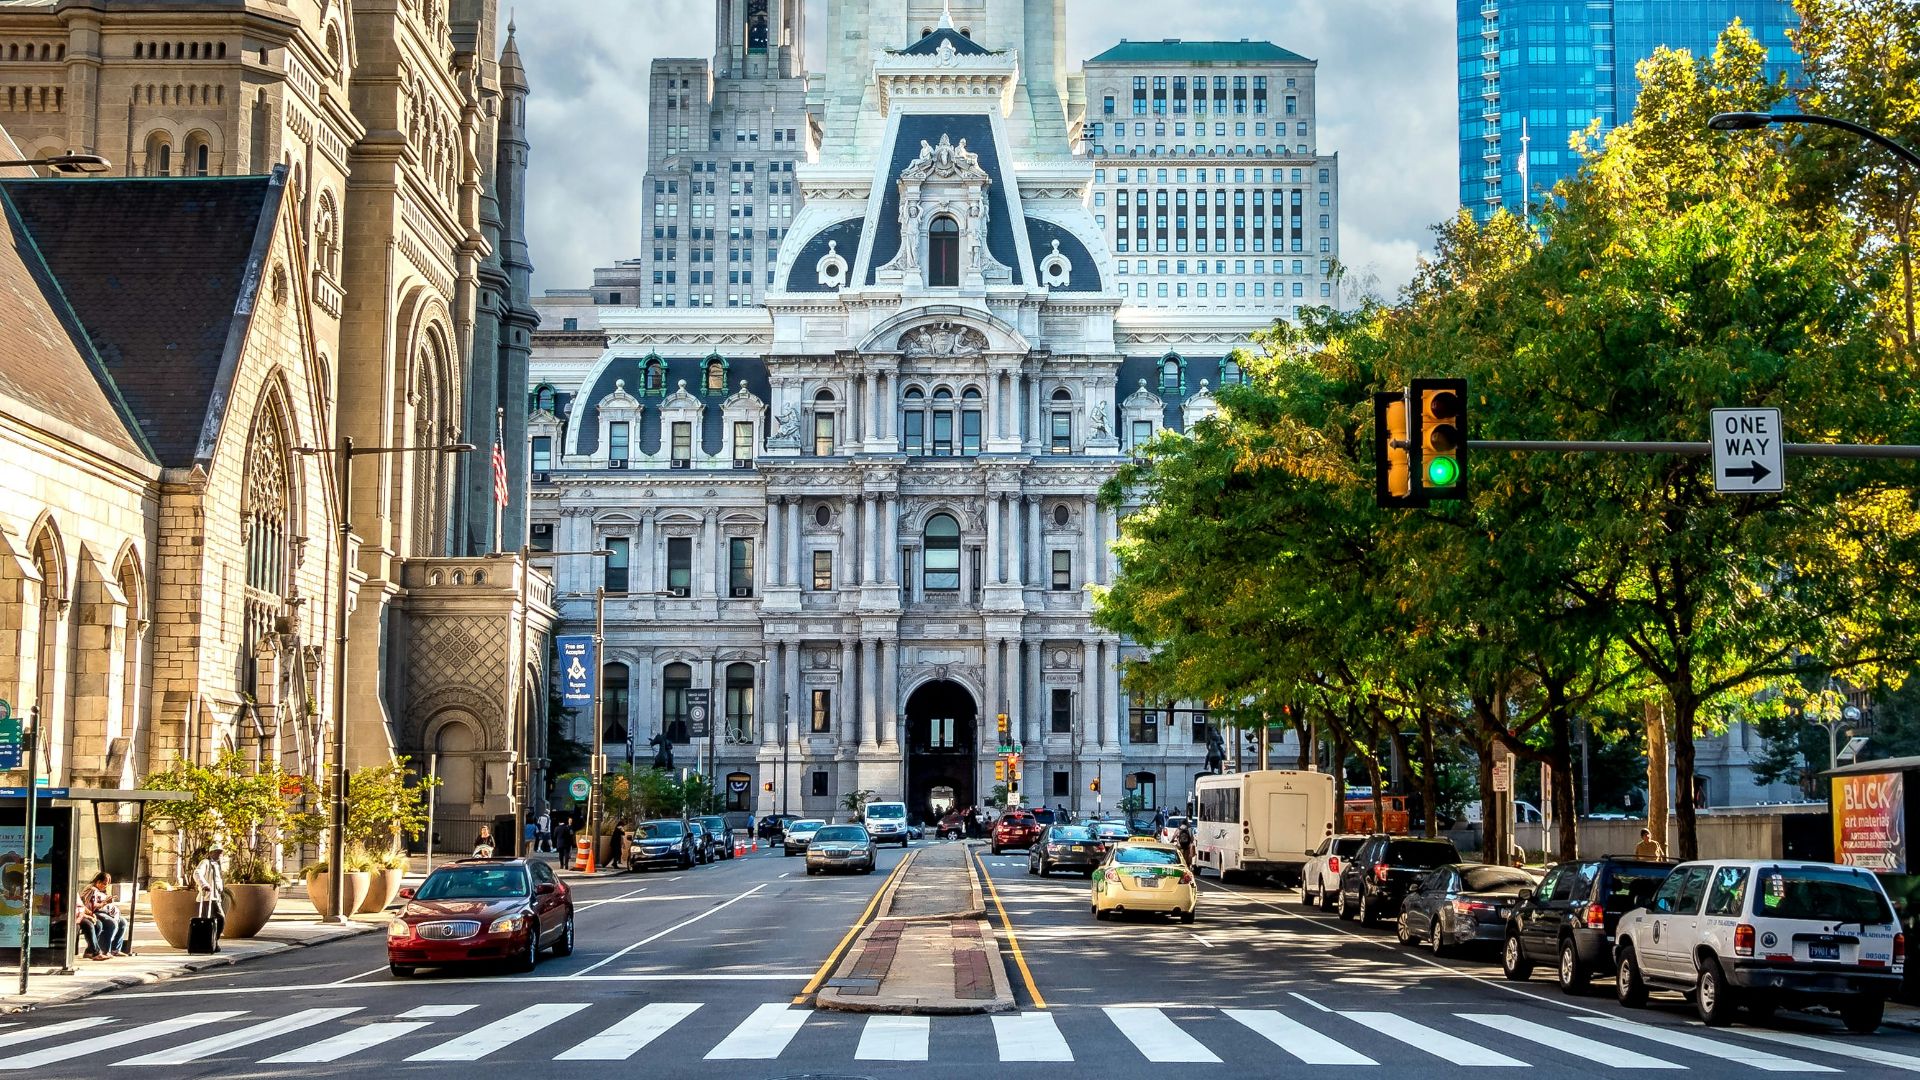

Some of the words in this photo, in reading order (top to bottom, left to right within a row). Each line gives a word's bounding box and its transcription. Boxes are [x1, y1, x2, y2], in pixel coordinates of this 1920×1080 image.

[1725, 416, 1767, 434] ONE
[1725, 438, 1770, 456] WAY
[1844, 780, 1890, 809] BLICK
[1845, 815, 1857, 828] art
[1858, 813, 1890, 828] materials
[1857, 931, 1893, 939] PHILADELPHIA
